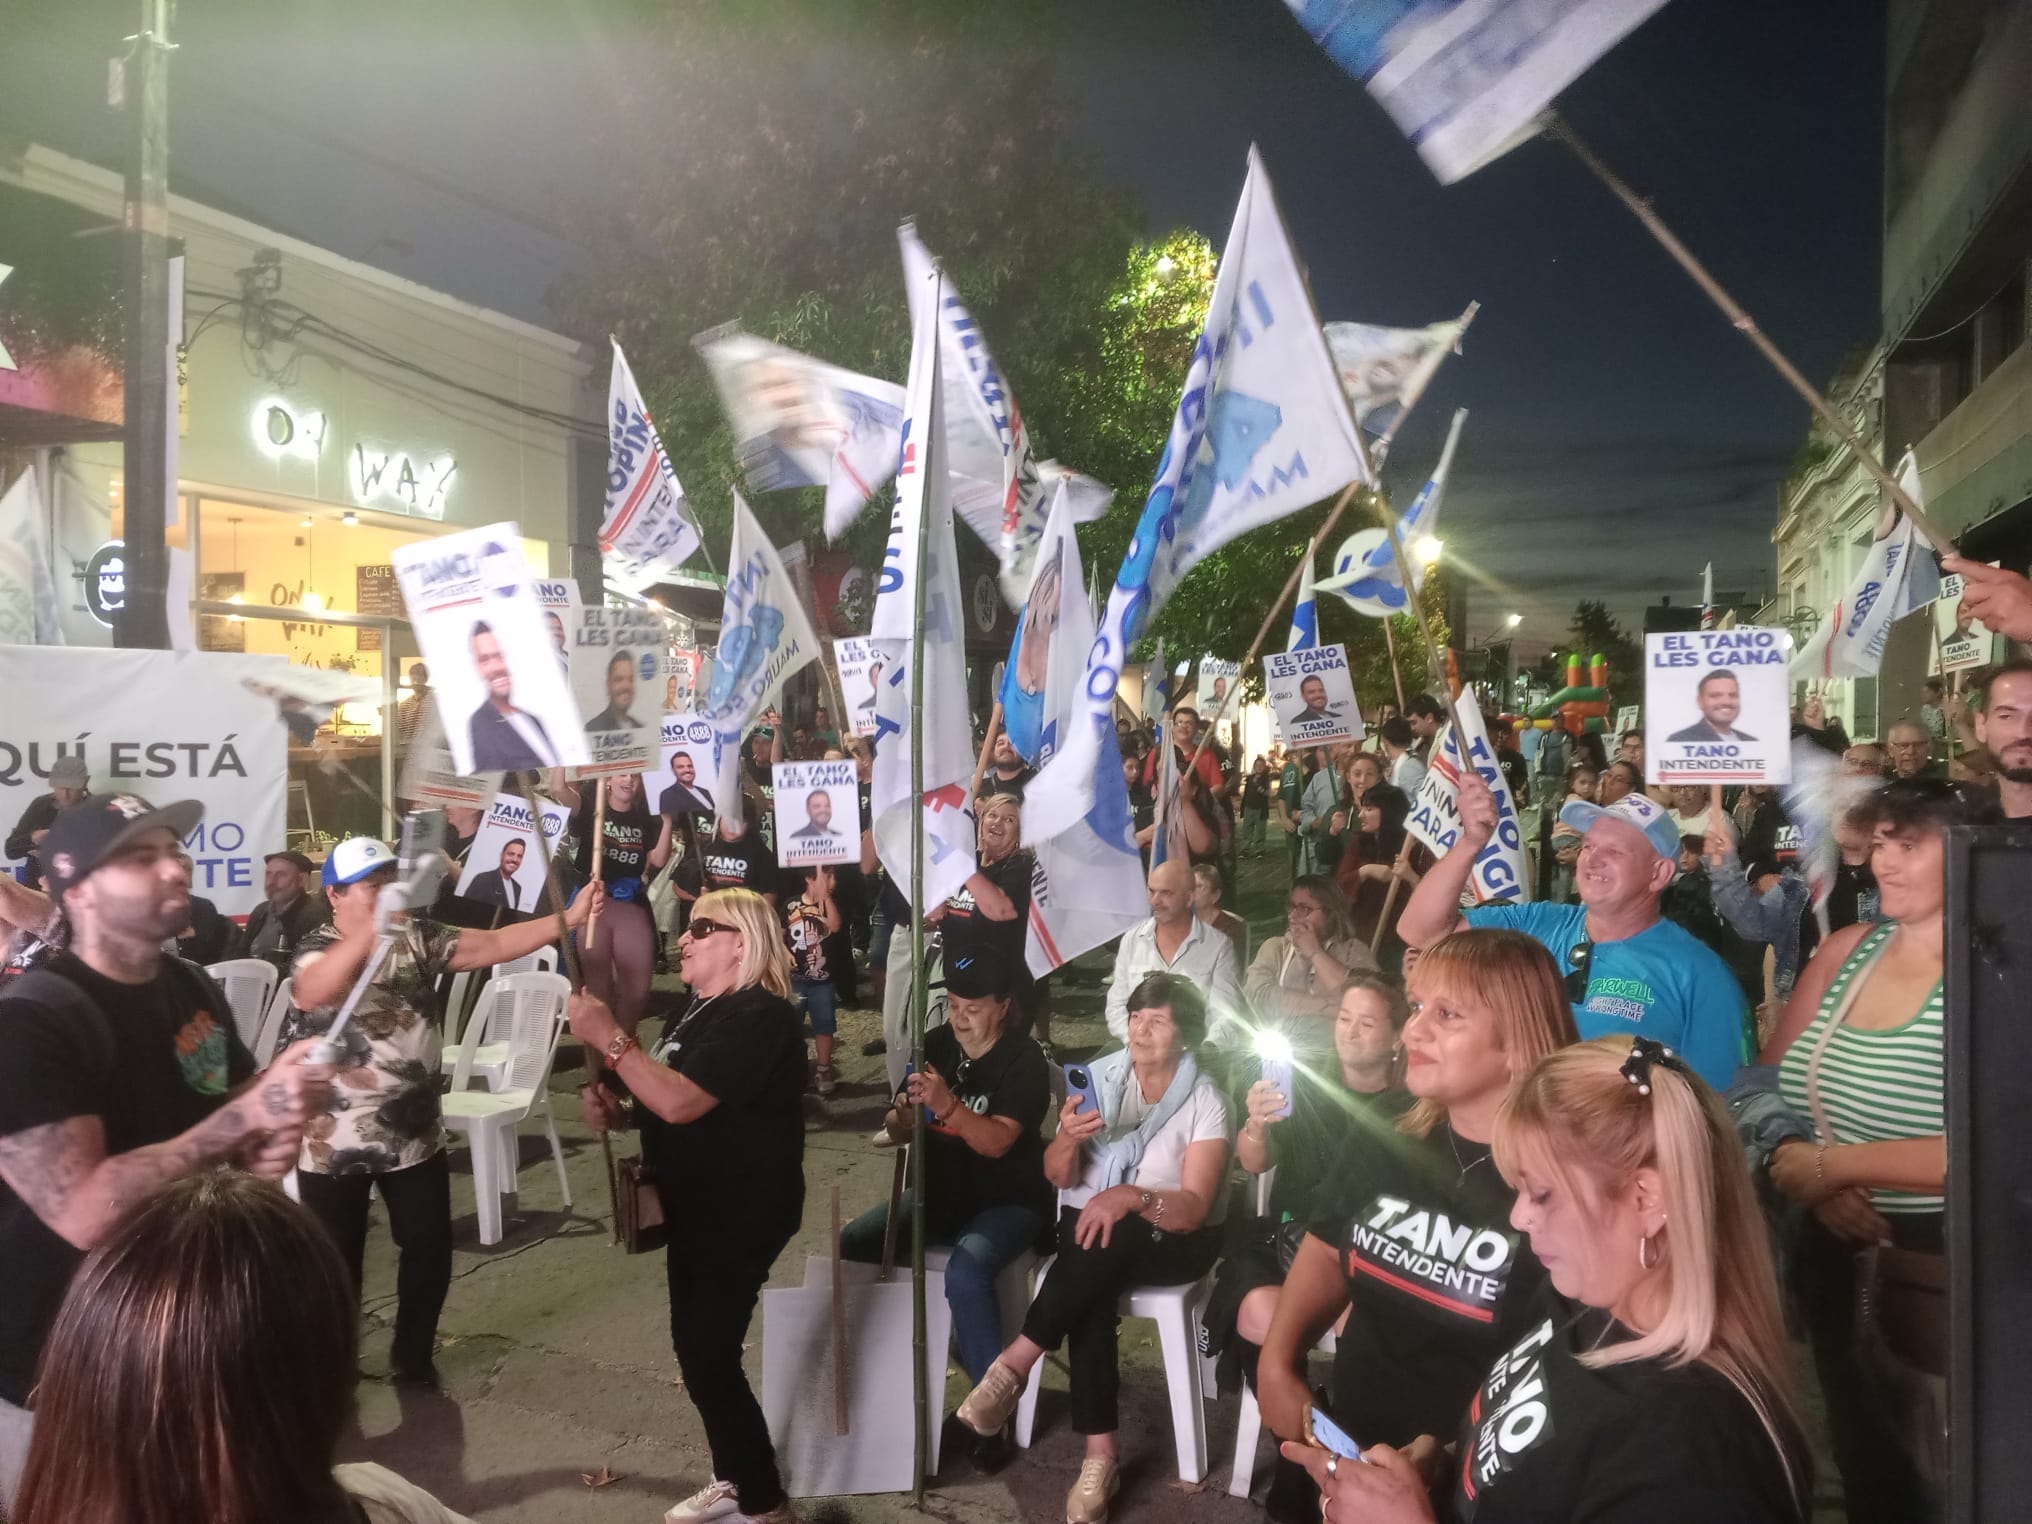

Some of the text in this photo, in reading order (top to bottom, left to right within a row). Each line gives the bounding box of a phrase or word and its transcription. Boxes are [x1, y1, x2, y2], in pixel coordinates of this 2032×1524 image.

[355, 442, 458, 508] WAY
[366, 566, 392, 578] CAFE
[1945, 574, 1958, 588] EL
[1941, 587, 1960, 600] LES
[584, 610, 606, 627] EL
[576, 629, 609, 647] LES
[1664, 633, 1775, 651] EL TANO
[844, 640, 861, 652] EL
[1947, 642, 1971, 655] TANO
[840, 651, 867, 664] LES
[1274, 647, 1338, 667] EL TANO
[1654, 650, 1785, 668] LES GANA
[1271, 658, 1346, 679] LES GANA
[688, 724, 712, 742] 4888
[1290, 726, 1350, 740] INTENDENTE
[1302, 720, 1334, 732] TANO
[109, 733, 249, 778] ESTÁ
[1683, 745, 1740, 758] TANO
[783, 764, 849, 777] EL TANO
[1659, 759, 1765, 770] INTENDENTE
[778, 775, 856, 790] LES GANA
[487, 814, 535, 831] INTENDENTE
[604, 821, 643, 839] TANO
[801, 838, 834, 850] TANO
[705, 855, 748, 871] TANO
[1620, 1008, 1642, 1021] TIME
[1368, 1198, 1510, 1273] TANO
[1353, 1223, 1499, 1302] INTENDENTE
